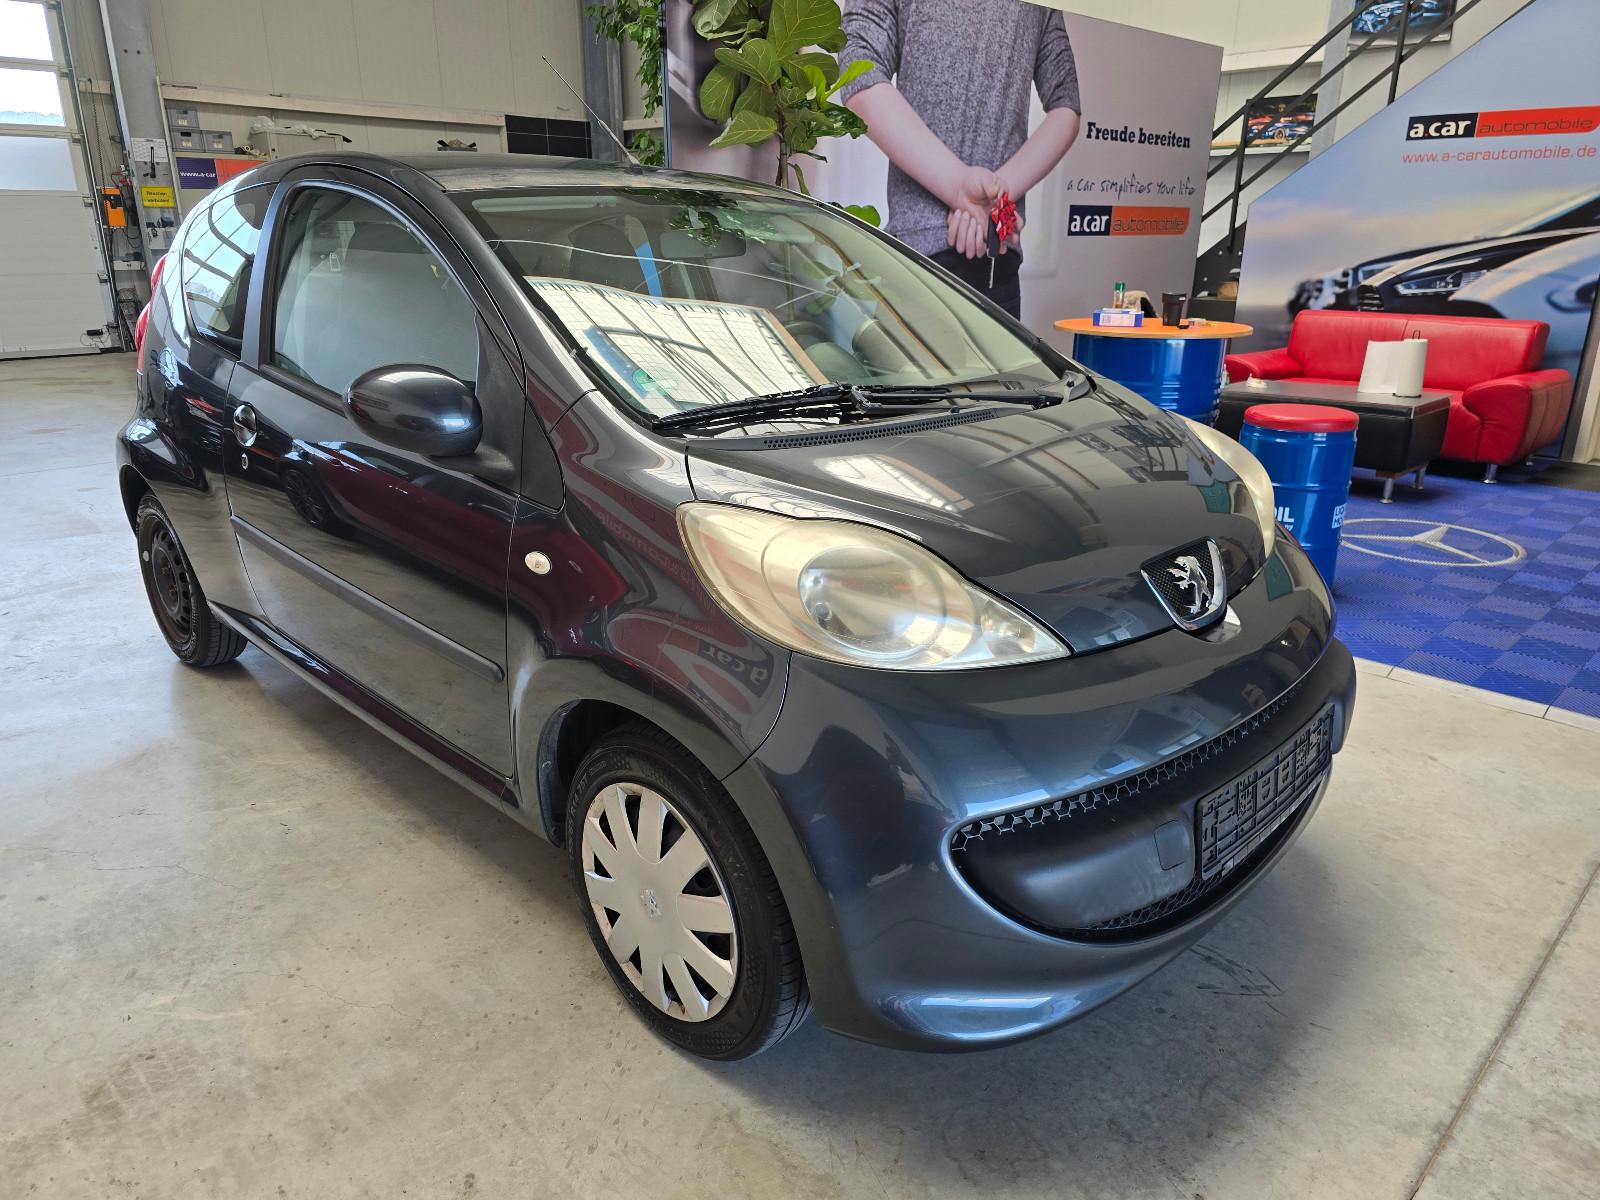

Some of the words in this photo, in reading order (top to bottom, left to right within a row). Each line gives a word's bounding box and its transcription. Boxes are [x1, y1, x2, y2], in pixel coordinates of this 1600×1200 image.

[1480, 117, 1593, 133] automobile
[1086, 121, 1136, 144] Freude
[1138, 127, 1191, 149] bereiten
[1113, 215, 1185, 232] automobile
[1274, 506, 1295, 523] IL
